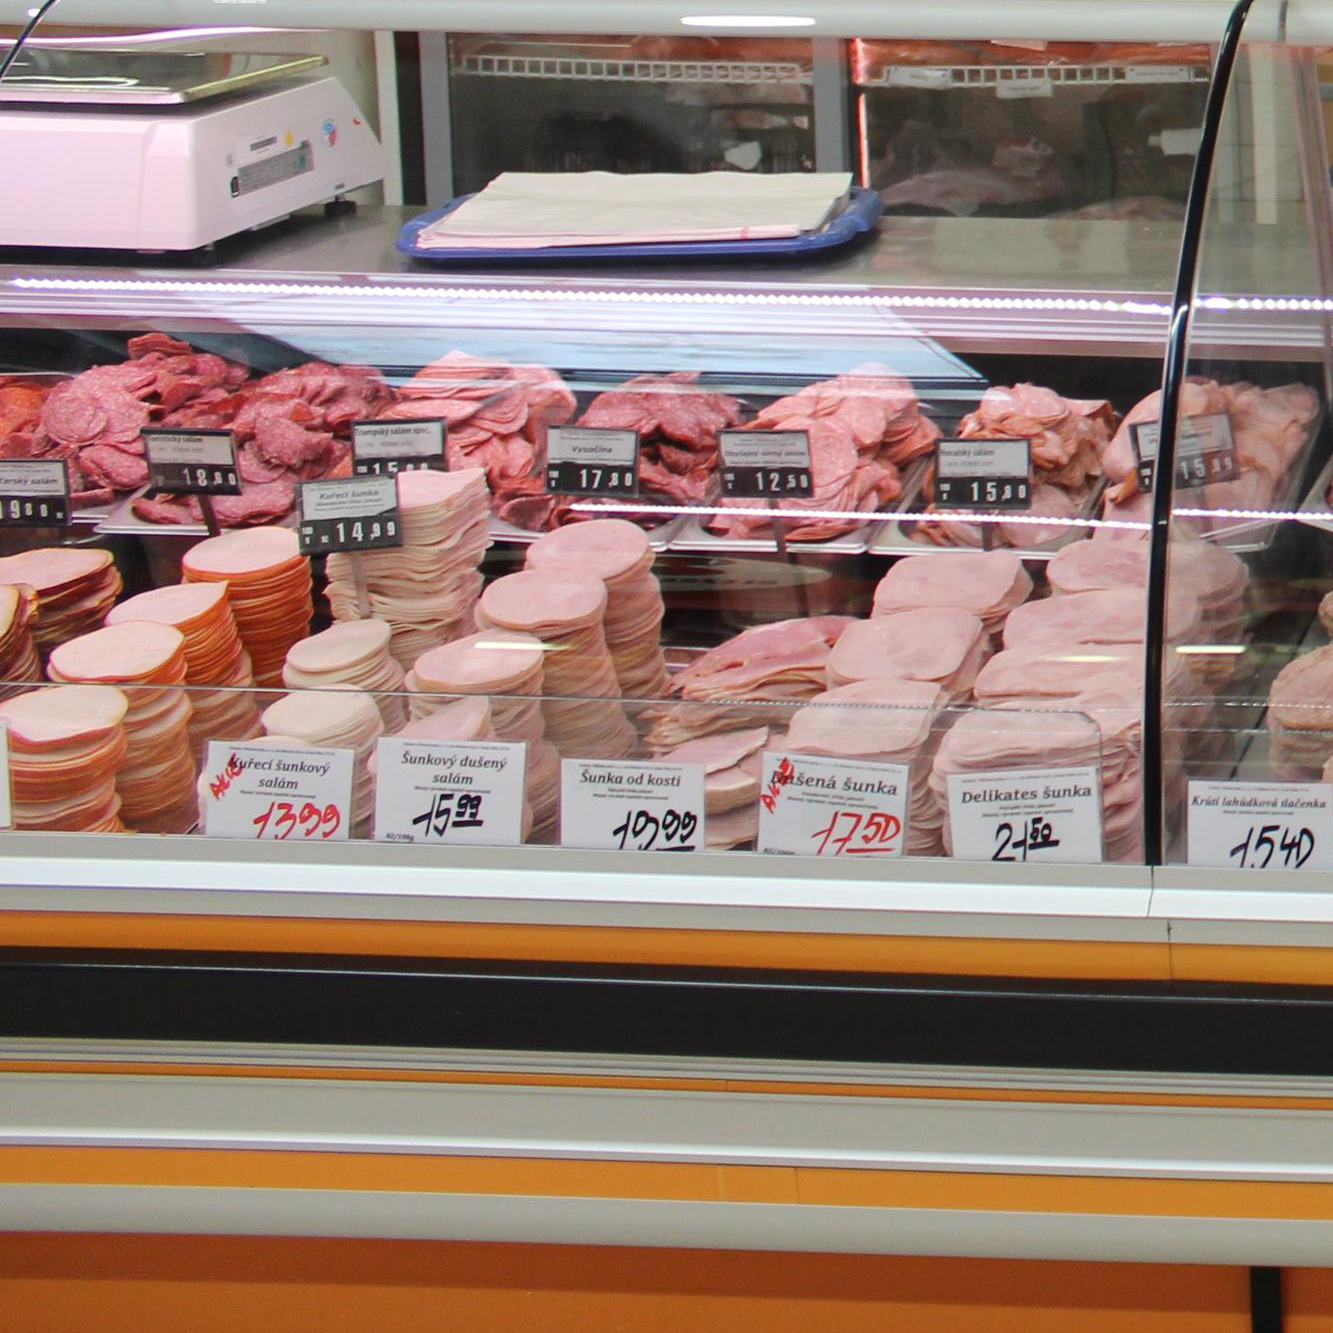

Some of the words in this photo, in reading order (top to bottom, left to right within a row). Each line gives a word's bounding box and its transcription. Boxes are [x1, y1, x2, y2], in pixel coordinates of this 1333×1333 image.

[571, 443, 613, 455] Vysočina
[232, 755, 274, 772] Kuřecí
[275, 760, 330, 778] šunkový
[401, 750, 457, 769] Šunkový
[460, 754, 508, 772] dušený
[258, 777, 300, 790] salám
[433, 773, 474, 786] salám
[580, 768, 622, 785] Šunka
[626, 772, 644, 785] od
[647, 772, 681, 788] kosti
[842, 776, 898, 796] šunka
[961, 788, 1043, 805] Delikates
[1043, 784, 1092, 800] šunka
[1281, 796, 1327, 809] tlačenka
